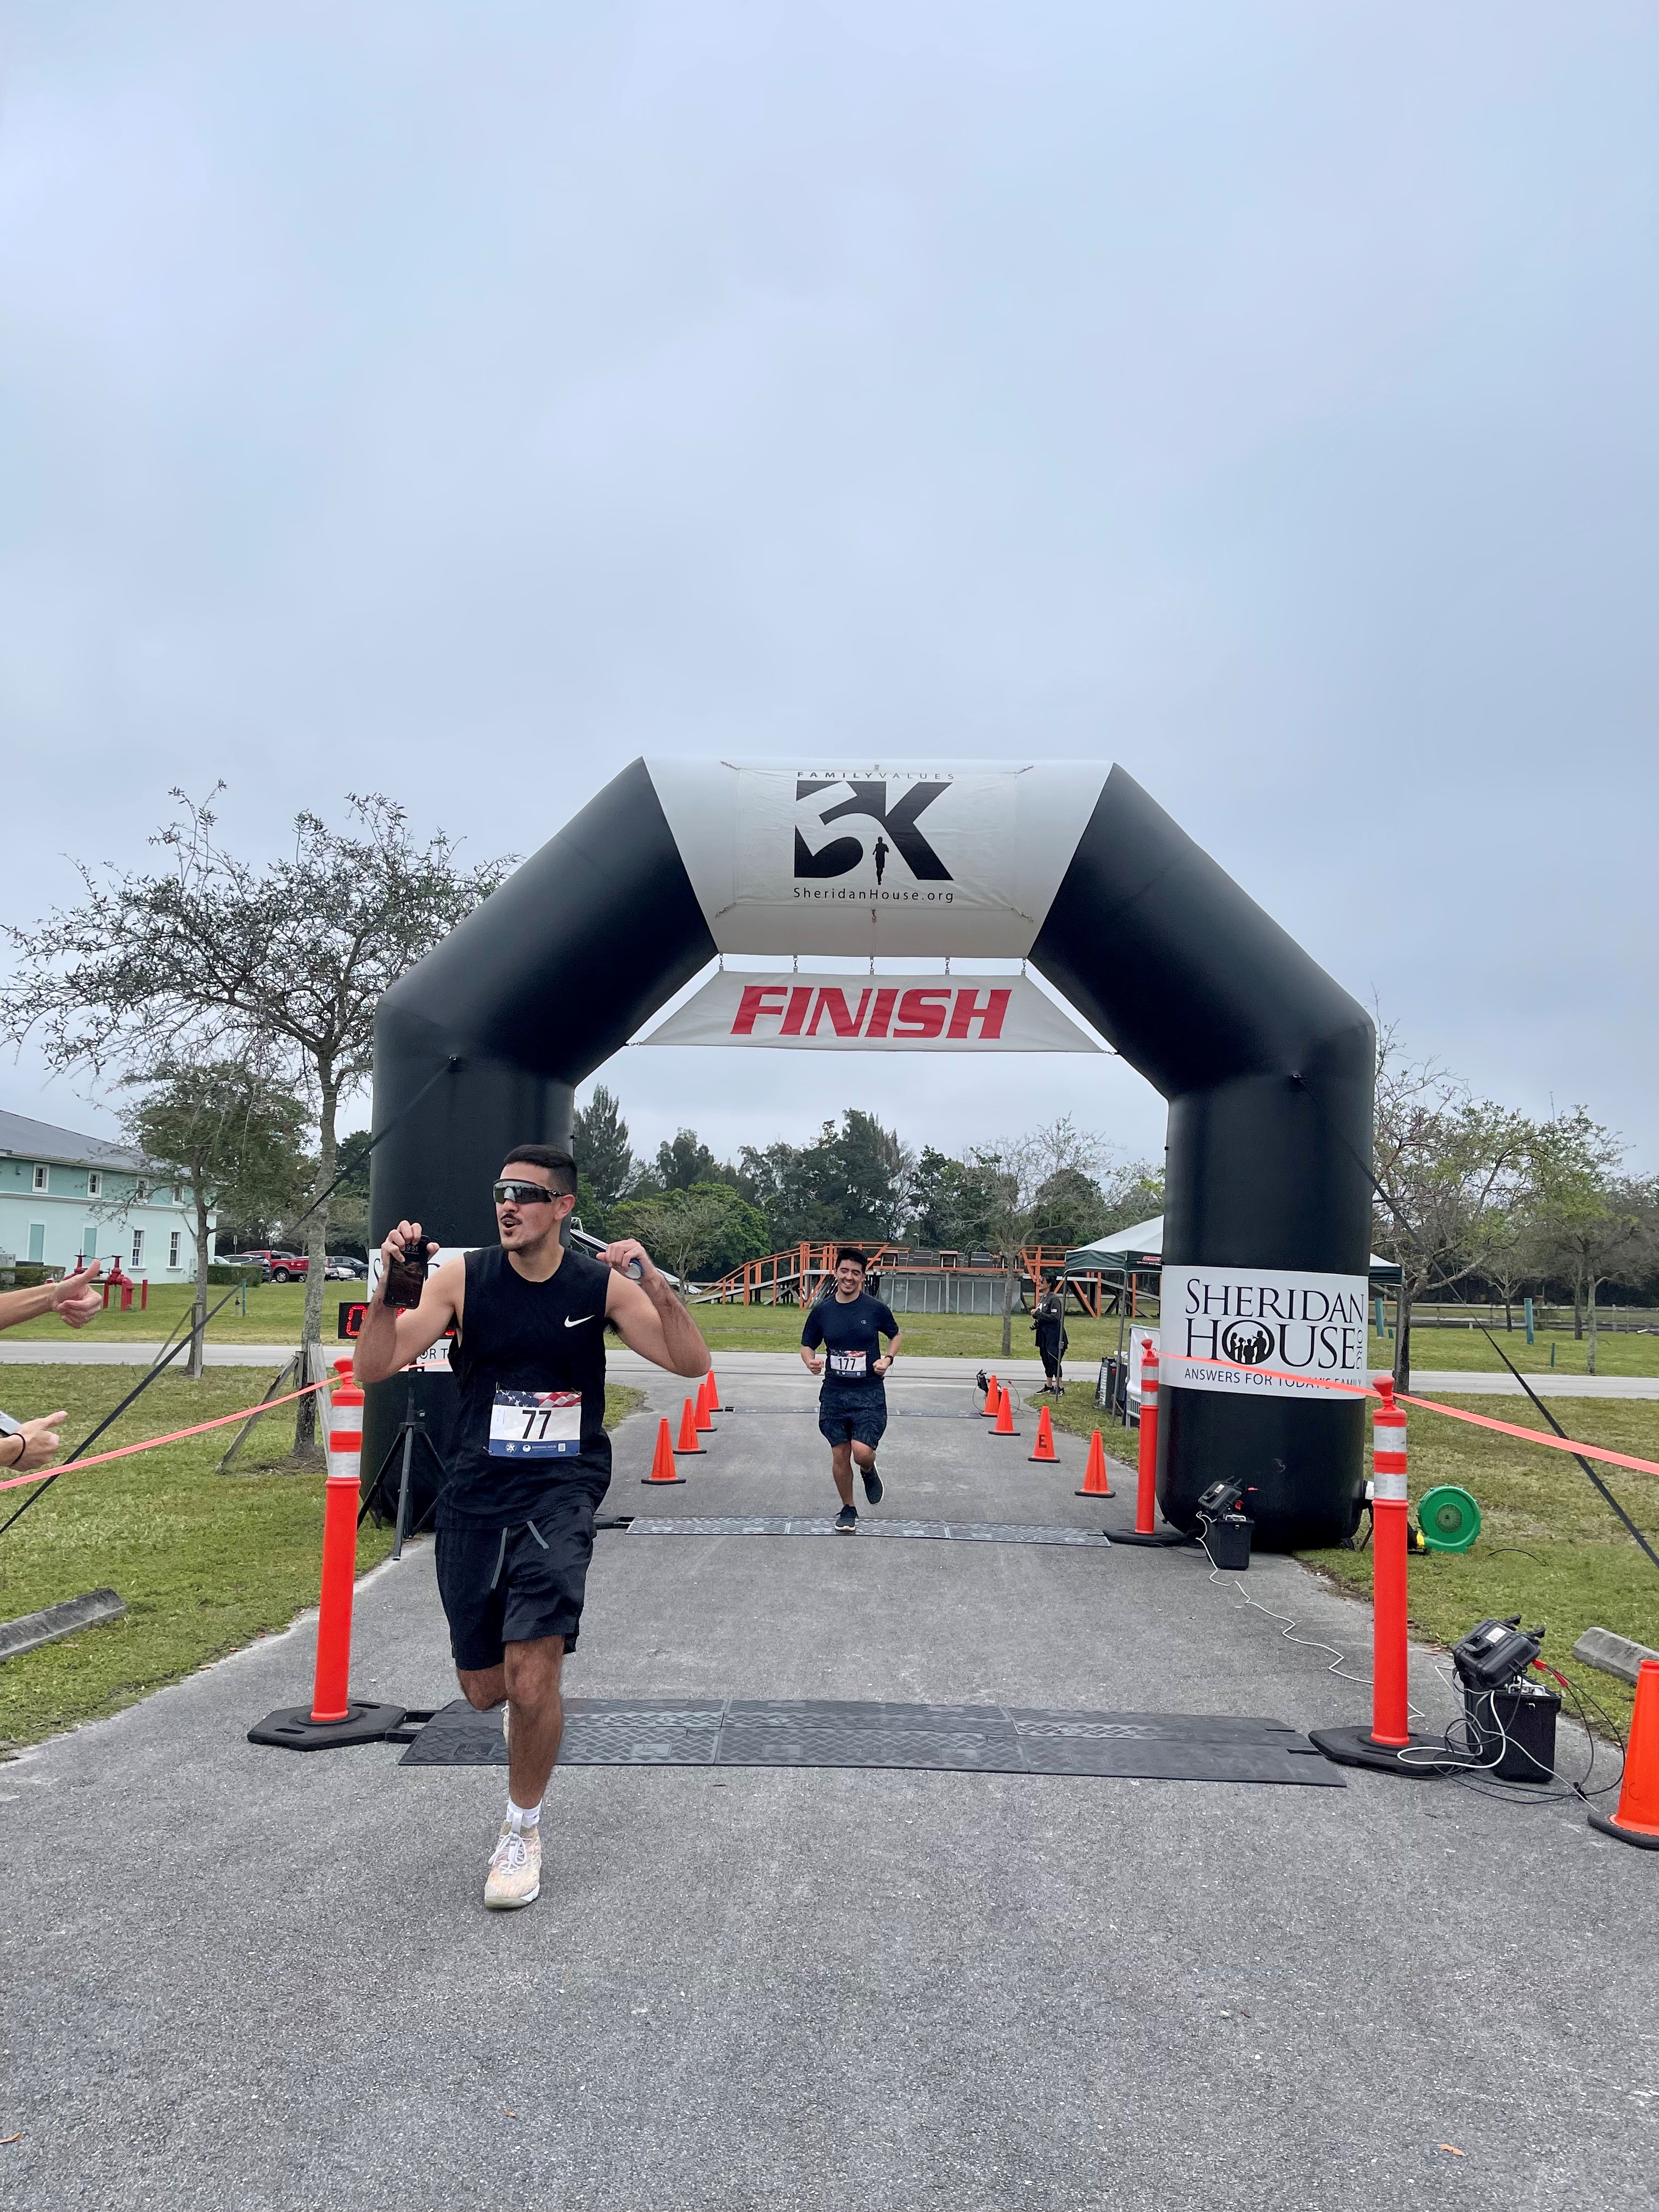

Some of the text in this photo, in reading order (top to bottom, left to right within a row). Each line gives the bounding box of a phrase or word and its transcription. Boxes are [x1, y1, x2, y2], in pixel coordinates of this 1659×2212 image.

[794, 780, 954, 881] 5K
[794, 888, 953, 903] SheridanHouse.org
[730, 985, 1012, 1039] FINISH
[1186, 1279, 1364, 1324] SHERIDAN
[420, 1348, 437, 1359] OR
[1186, 1318, 1355, 1369] HOUSE
[838, 1357, 856, 1370] 177
[1184, 1368, 1240, 1384] ANSWERS
[1245, 1373, 1273, 1386] FOR
[522, 1410, 552, 1440] 77
[1039, 1434, 1047, 1448] E
